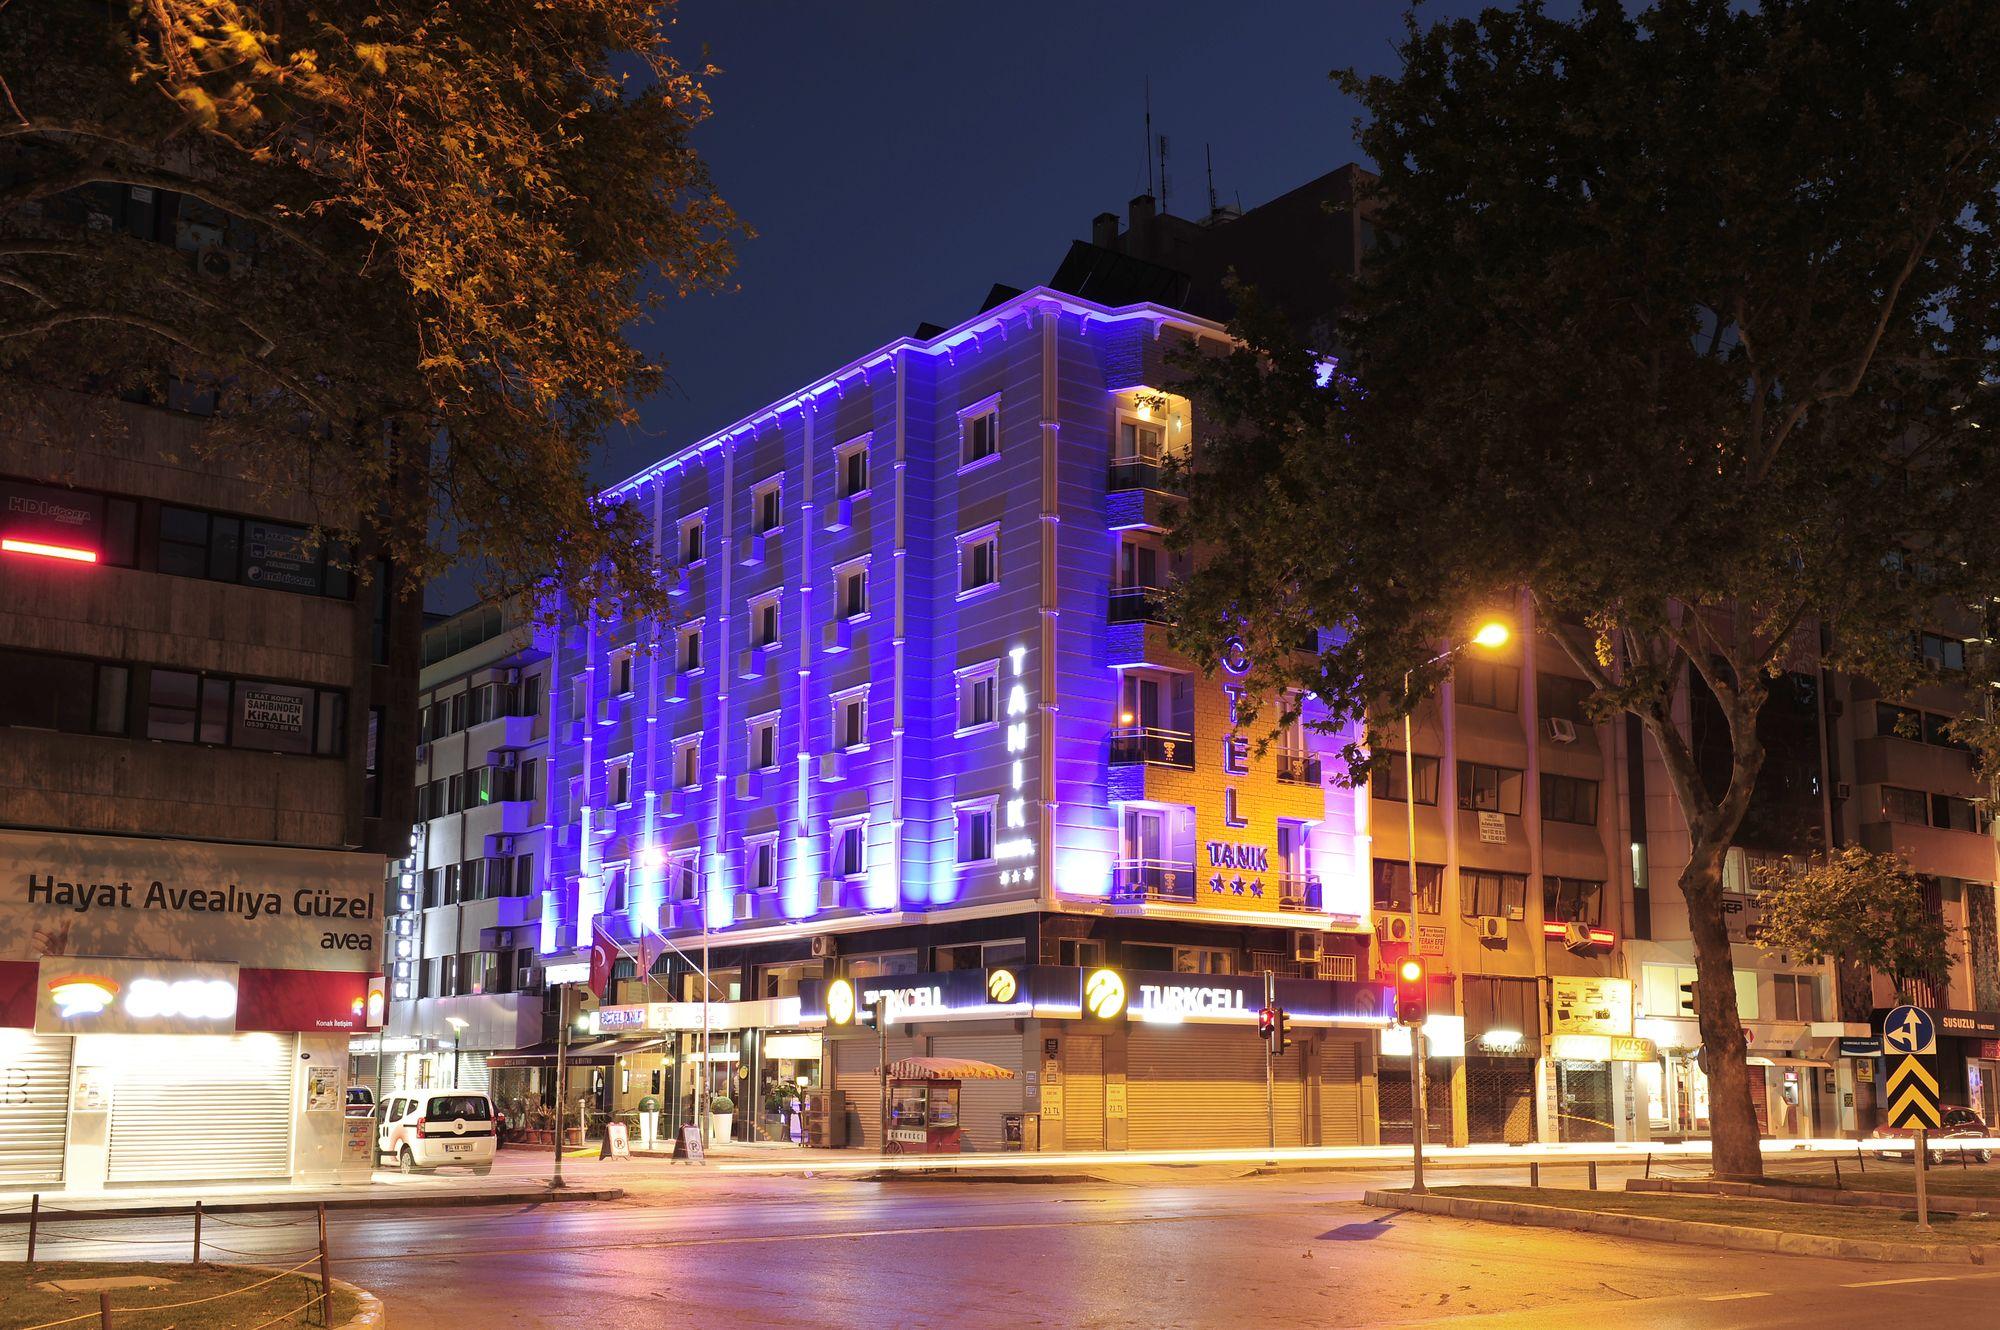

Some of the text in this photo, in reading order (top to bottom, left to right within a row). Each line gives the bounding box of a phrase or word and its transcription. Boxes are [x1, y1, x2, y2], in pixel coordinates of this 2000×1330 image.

[9, 496, 48, 515] HDI
[248, 699, 300, 714] SAHİBİNDEN
[248, 710, 300, 725] KİRALIK
[1007, 647, 1027, 829] TANIK
[1207, 842, 1268, 871] TANIK
[28, 874, 374, 920] Hayat Avealıya Güzel
[320, 930, 372, 951] avea
[1140, 985, 1244, 1012] TURKCELL
[1943, 1017, 1975, 1029] SUSUZLU
